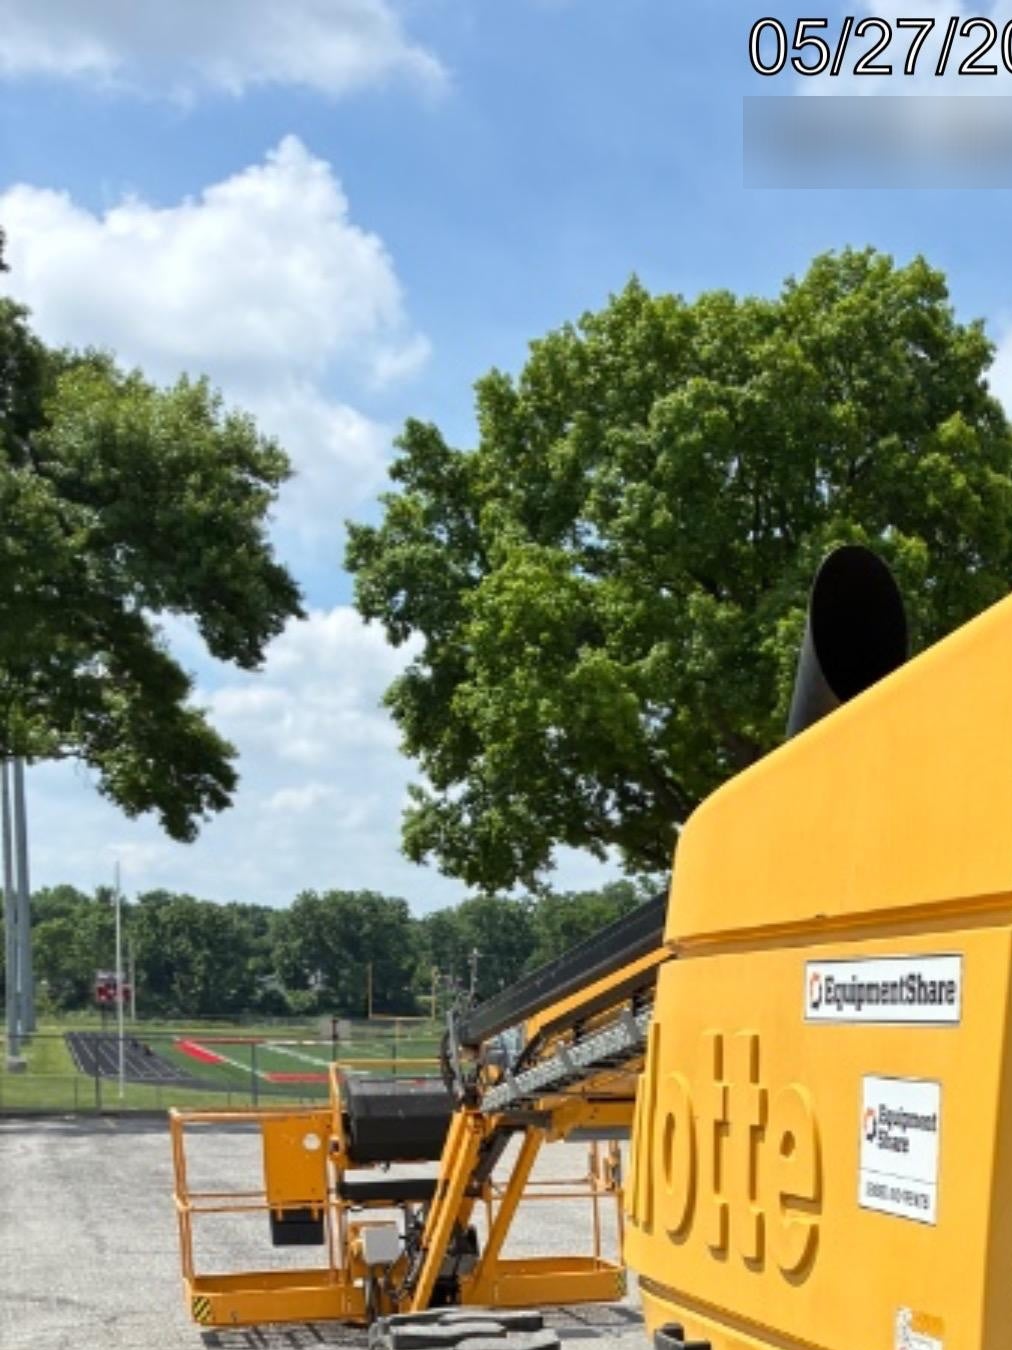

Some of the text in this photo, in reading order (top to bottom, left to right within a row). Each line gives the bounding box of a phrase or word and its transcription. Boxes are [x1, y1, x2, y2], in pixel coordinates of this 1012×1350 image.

[824, 972, 956, 1012] EquipmentShare
[878, 1103, 937, 1132] Equipment
[627, 1022, 825, 1288] lotte
[878, 1128, 910, 1153] Share
